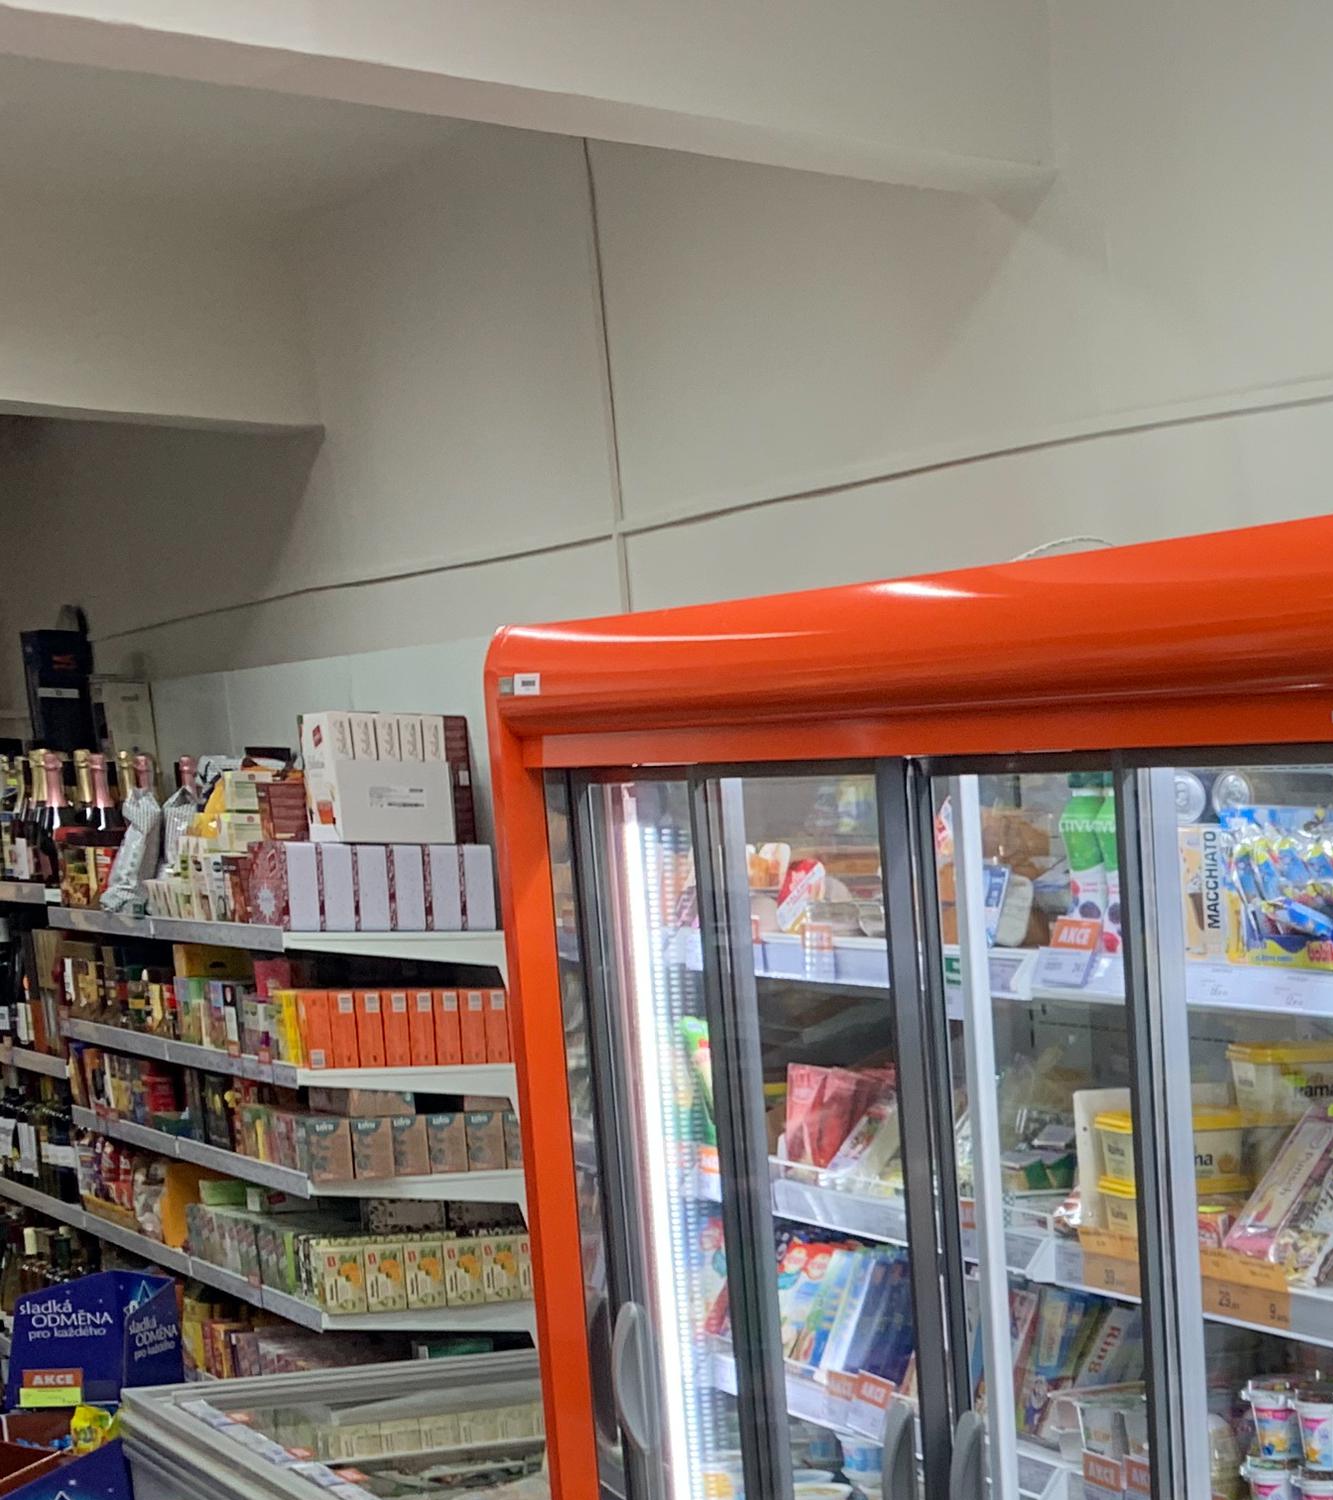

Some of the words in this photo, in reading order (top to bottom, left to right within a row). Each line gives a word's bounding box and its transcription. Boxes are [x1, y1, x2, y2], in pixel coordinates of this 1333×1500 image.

[1203, 830, 1221, 930] MACCHIATO
[1057, 926, 1093, 945] AKCE
[19, 1299, 73, 1316] sladká
[31, 1309, 113, 1329] ODMĚNA
[28, 1328, 51, 1342] pro
[53, 1326, 107, 1340] každého
[135, 1323, 179, 1348] ODMĚNA
[31, 1373, 75, 1386] AKCE
